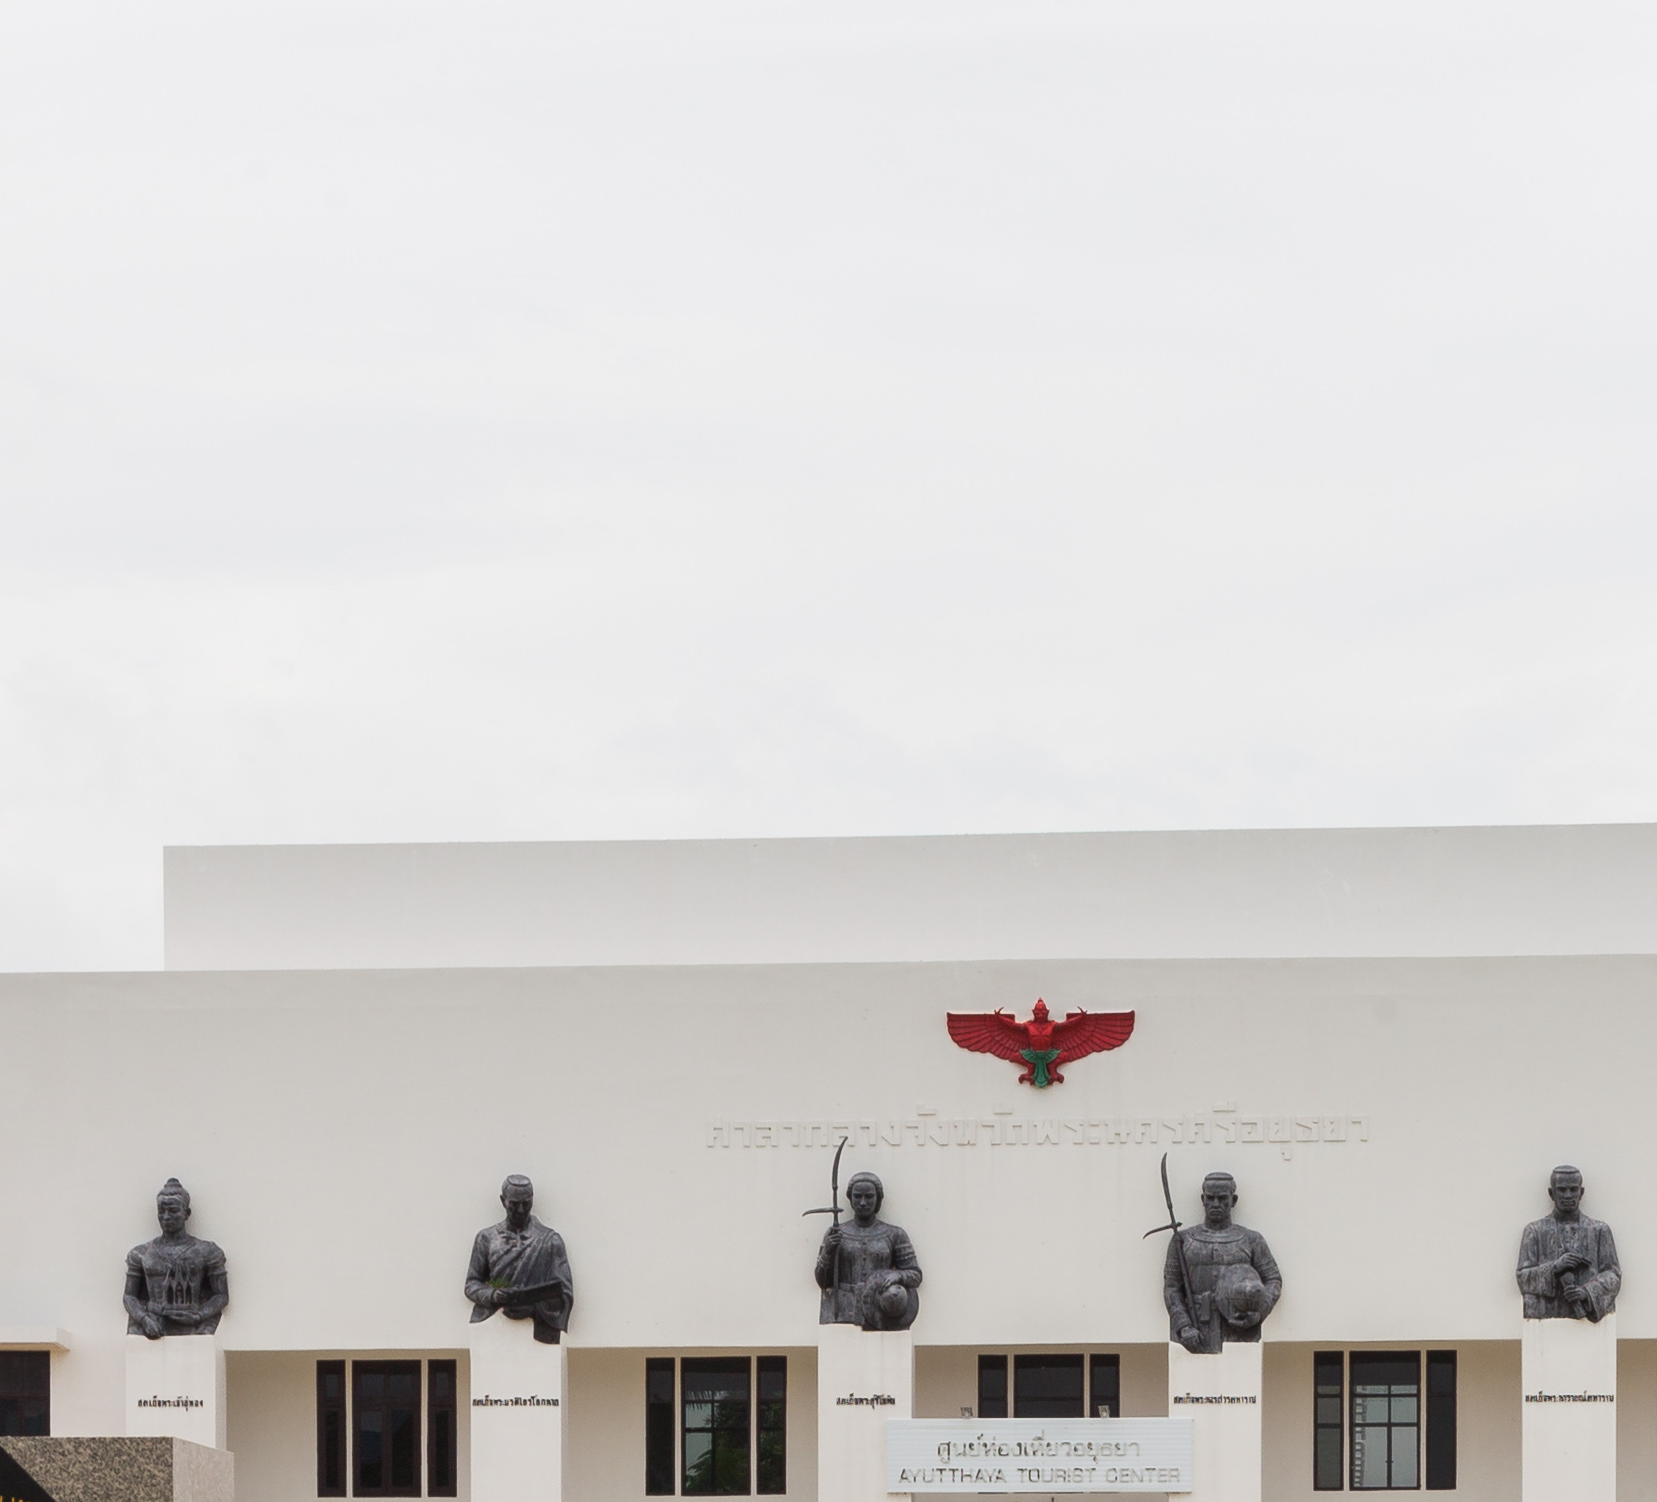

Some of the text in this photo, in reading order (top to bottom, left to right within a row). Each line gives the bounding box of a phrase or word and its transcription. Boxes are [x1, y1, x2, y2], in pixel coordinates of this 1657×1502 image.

[898, 1467, 1180, 1484] AYUTTHAYA TOURIST CENTER
